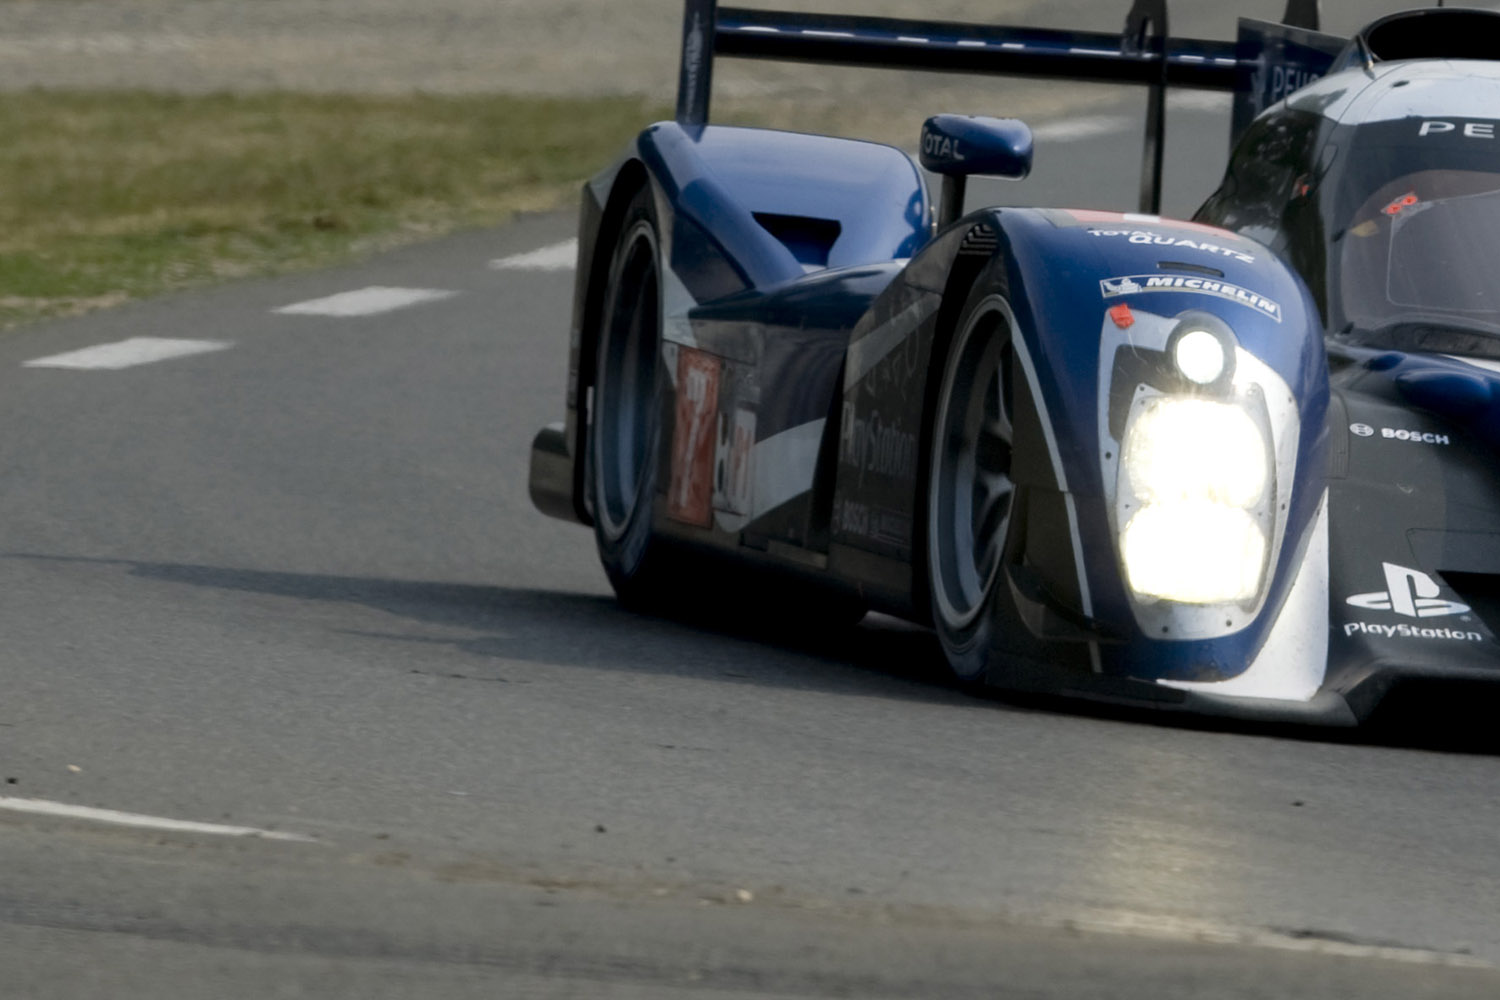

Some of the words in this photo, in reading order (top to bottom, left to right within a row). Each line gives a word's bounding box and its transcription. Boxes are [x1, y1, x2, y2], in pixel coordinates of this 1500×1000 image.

[1087, 229, 1159, 238] TOTAL
[1128, 235, 1256, 264] QUARTZ
[1146, 277, 1276, 313] MICHELIN
[1381, 427, 1450, 445] BOSCH
[1344, 621, 1482, 642] PlayStation
